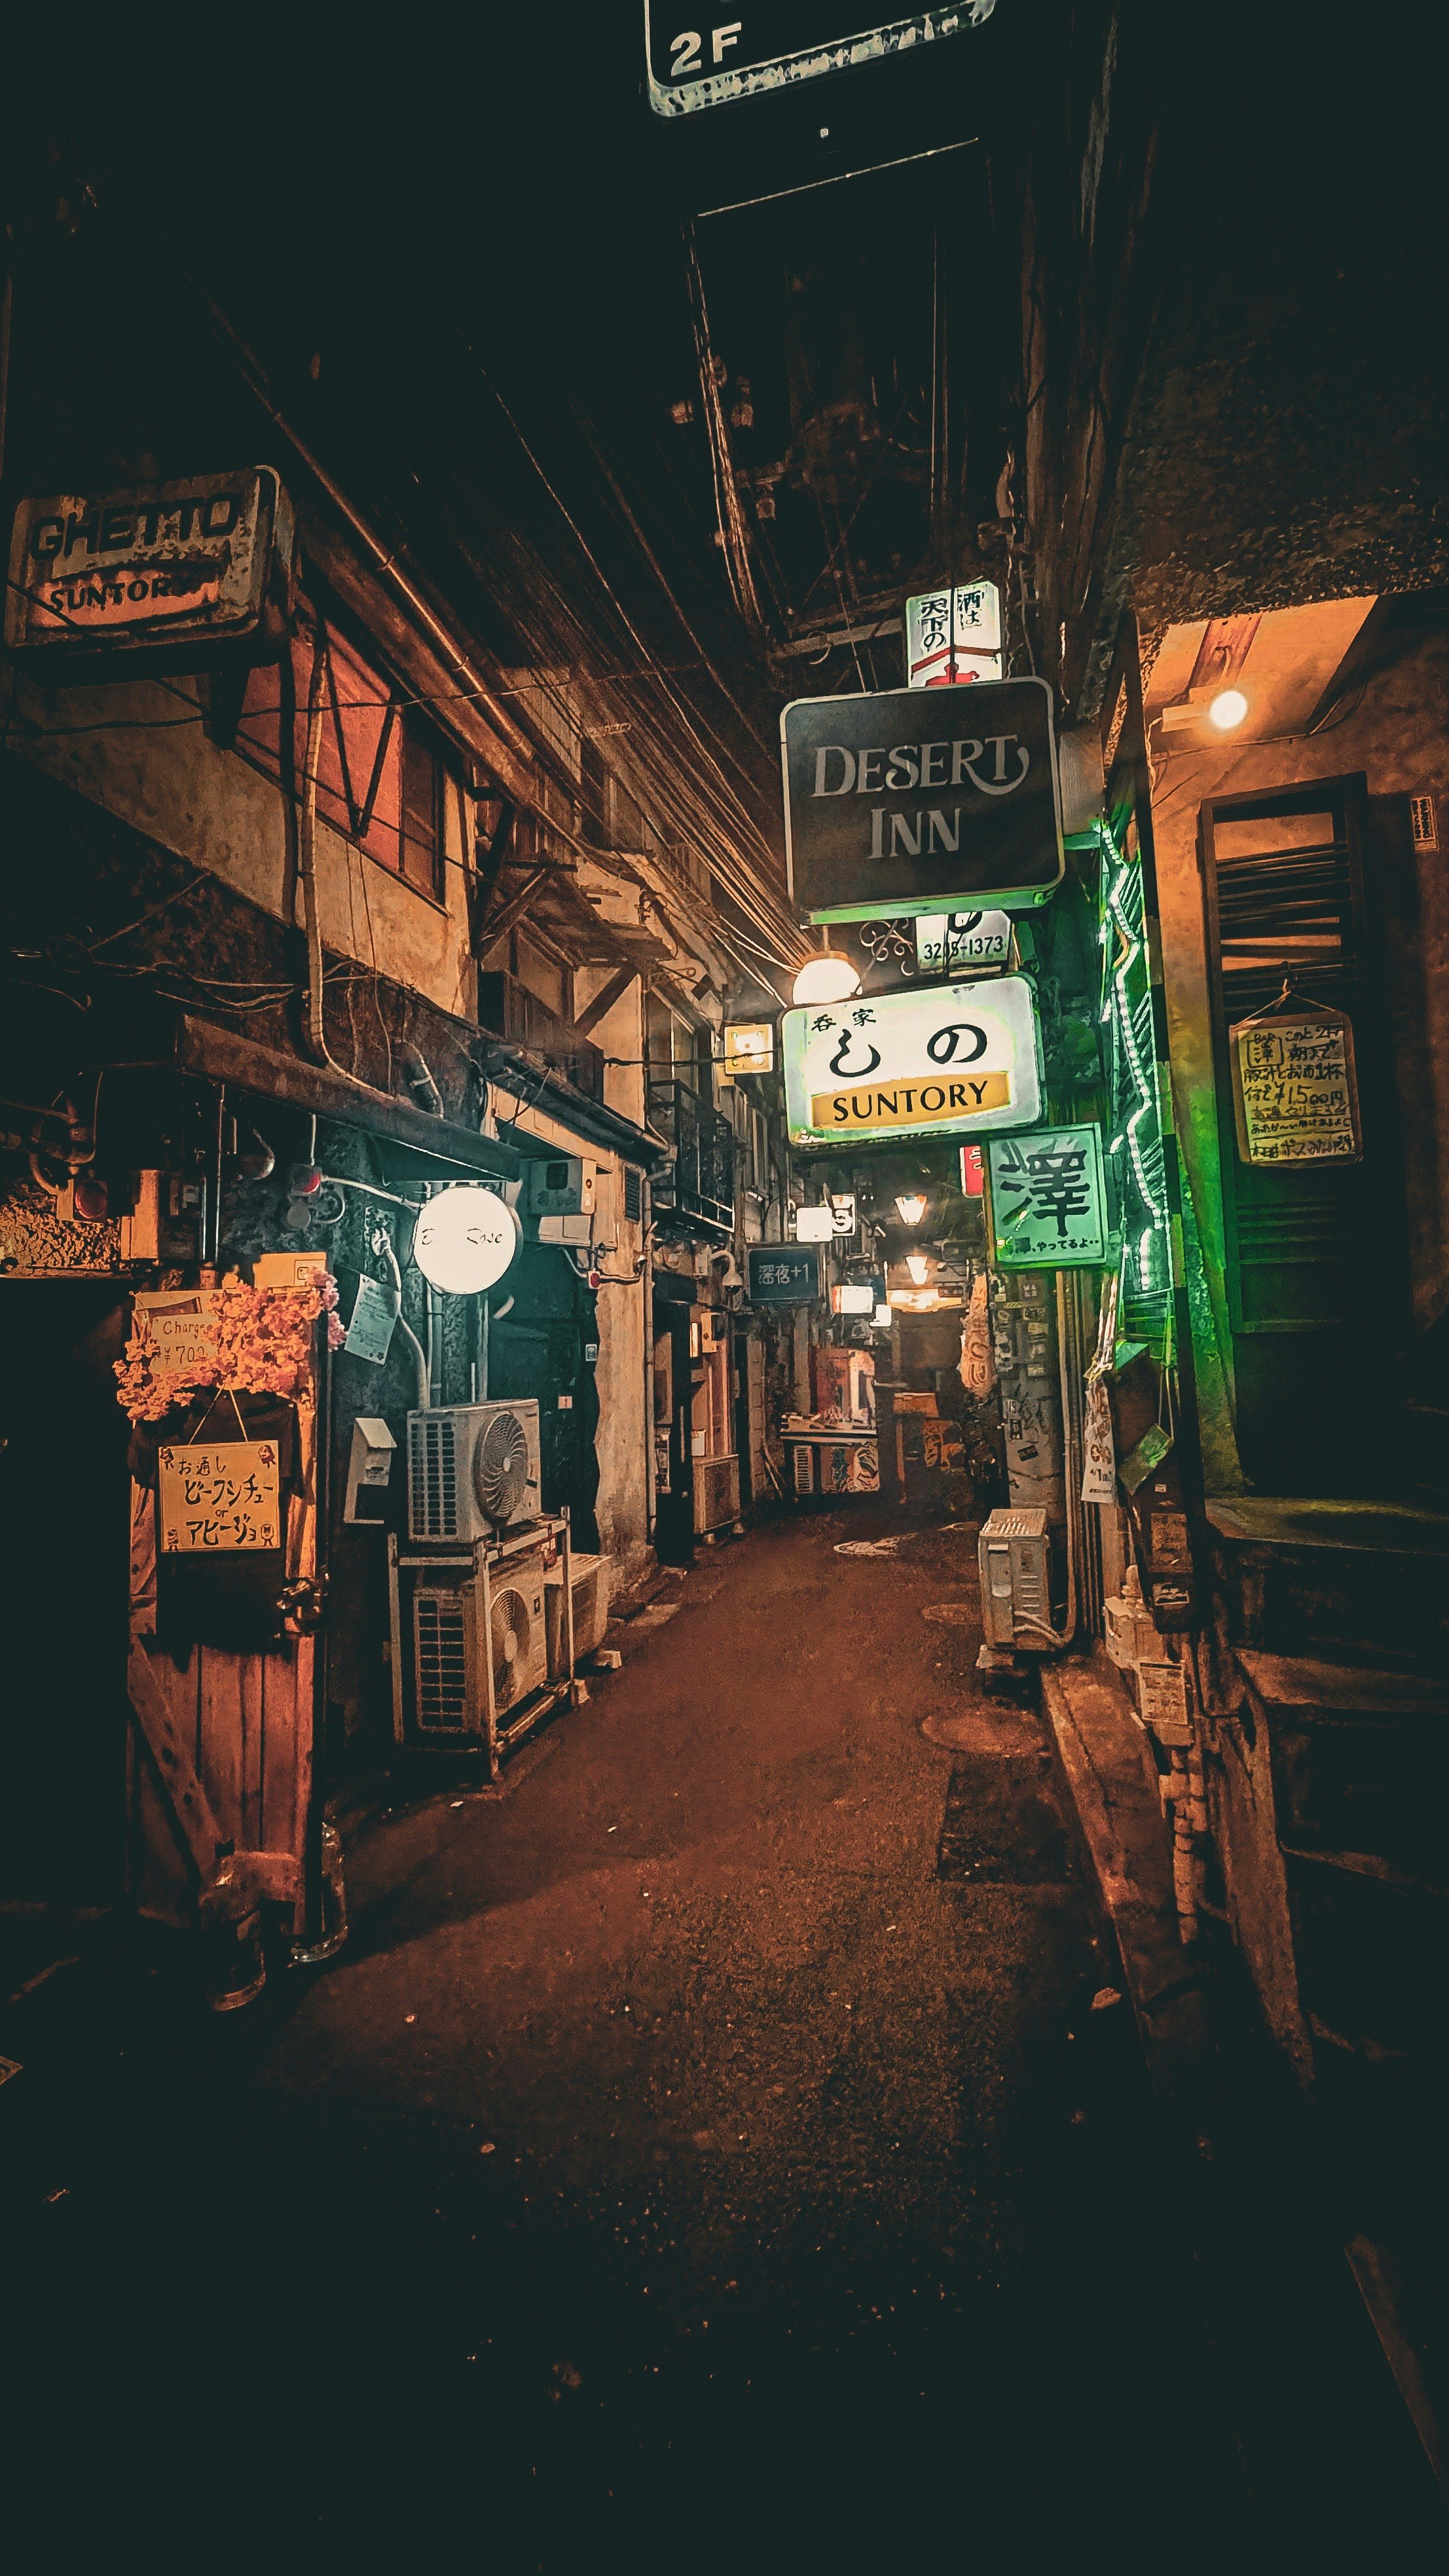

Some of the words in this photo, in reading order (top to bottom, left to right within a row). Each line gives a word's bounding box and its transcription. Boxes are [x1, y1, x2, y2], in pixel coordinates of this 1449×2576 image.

[670, 22, 742, 77] 2F
[30, 493, 241, 560] GHETTO
[918, 597, 949, 652] 天下の
[957, 589, 985, 630] 酒は
[811, 734, 1029, 797] DESERT
[867, 808, 961, 859] INN
[923, 935, 1004, 960] 328-1373
[811, 1008, 877, 1032] 呑家
[829, 1023, 988, 1078] しの
[832, 1080, 989, 1122] SUNTORY
[999, 1149, 1091, 1237] 澤
[759, 1263, 809, 1284] 深夜+1
[178, 1455, 227, 1476] お通し
[184, 1472, 274, 1507] ビーフシチュー
[185, 1513, 257, 1546] アヒージョ
[215, 1509, 229, 1518] or
